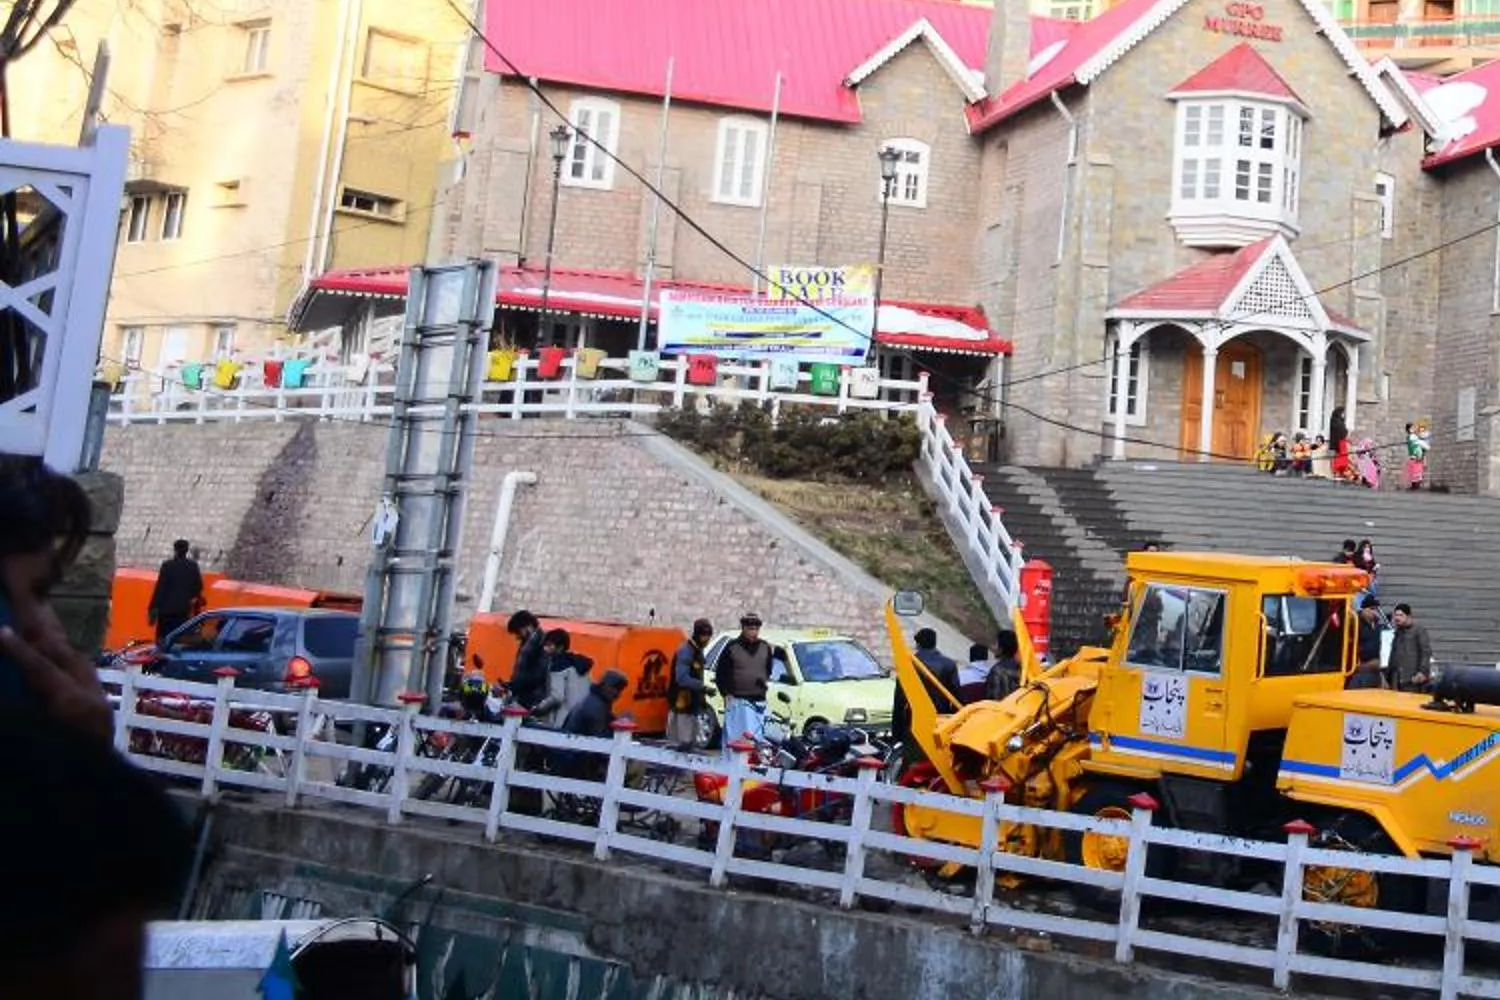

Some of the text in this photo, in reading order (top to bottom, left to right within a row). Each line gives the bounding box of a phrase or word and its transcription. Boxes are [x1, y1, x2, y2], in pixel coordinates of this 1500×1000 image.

[1226, 1, 1264, 20] GPO
[1204, 15, 1283, 42] MURREE
[779, 269, 847, 286] BOOK
[1143, 678, 1185, 714] پنجاب
[1343, 720, 1393, 759] پنجاب
